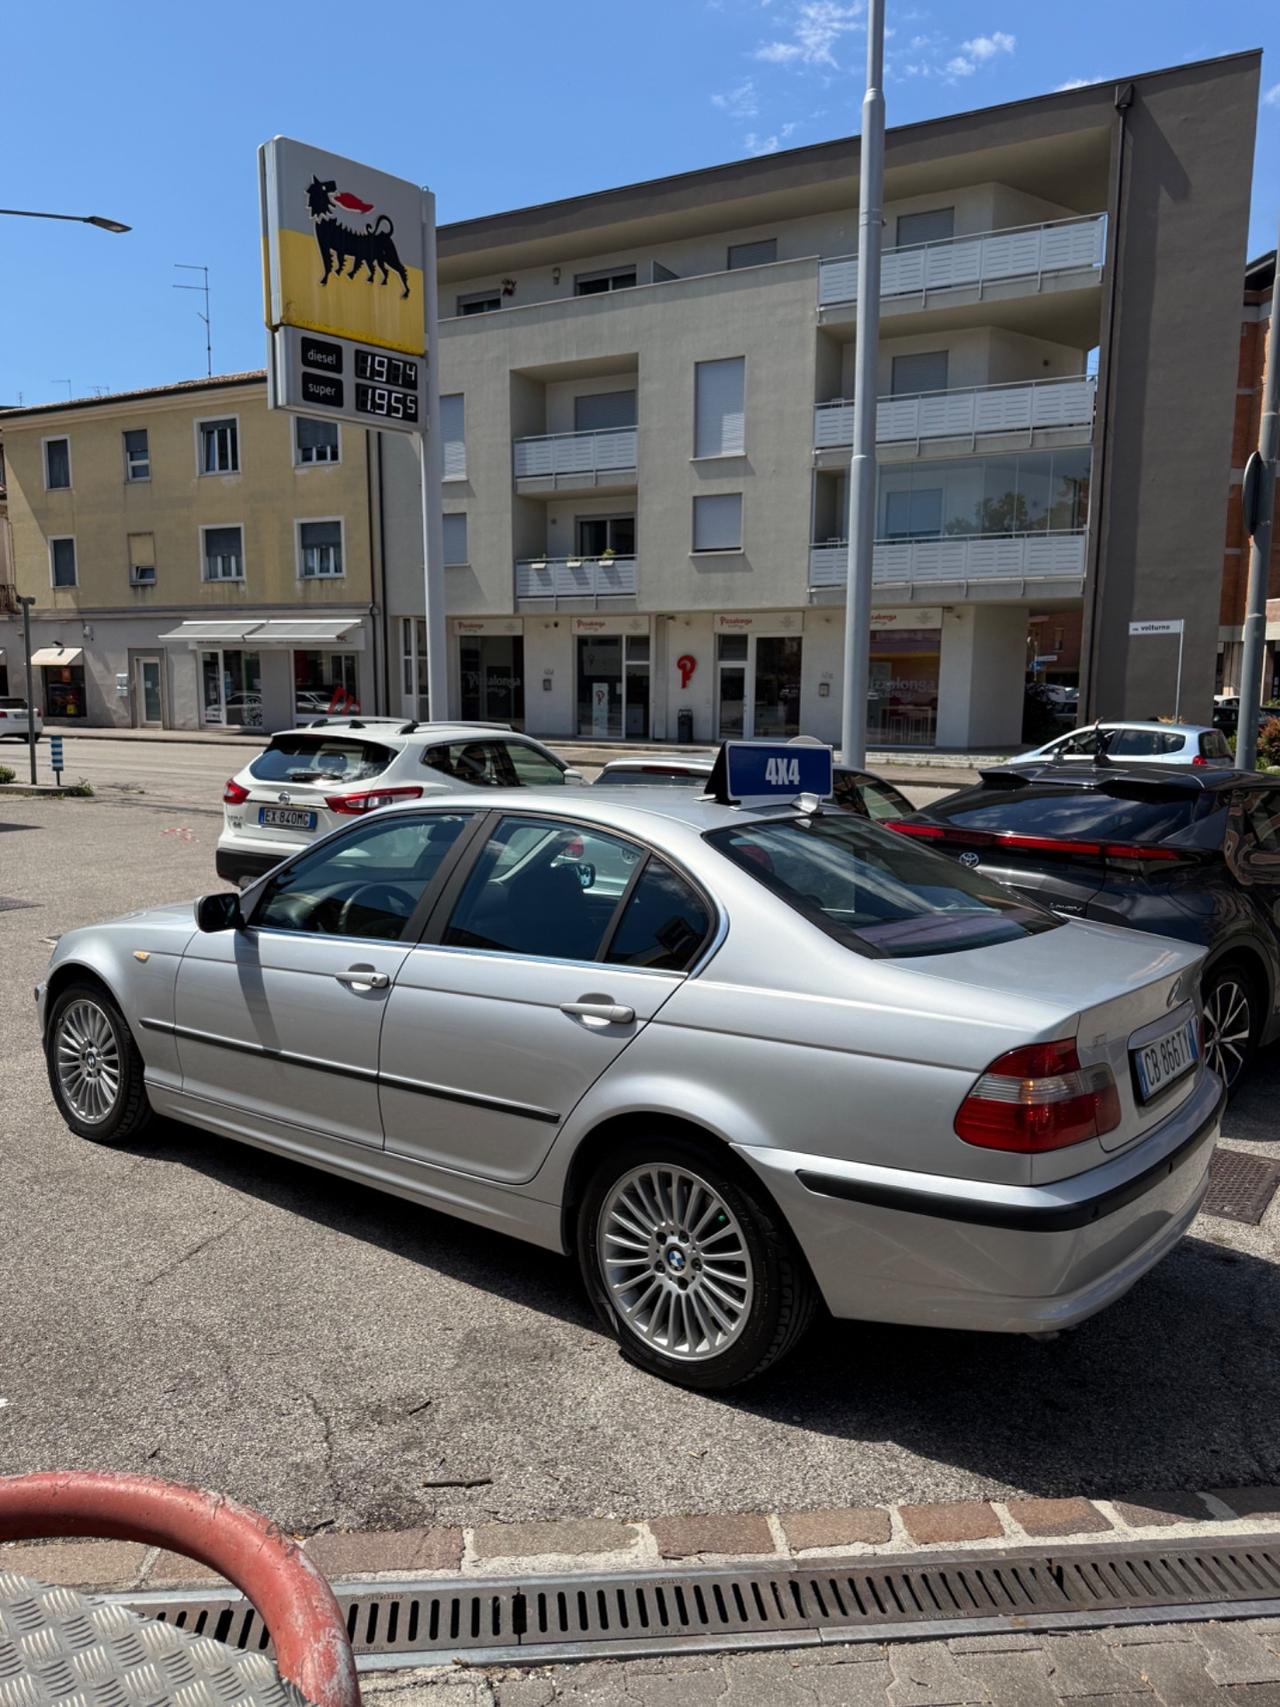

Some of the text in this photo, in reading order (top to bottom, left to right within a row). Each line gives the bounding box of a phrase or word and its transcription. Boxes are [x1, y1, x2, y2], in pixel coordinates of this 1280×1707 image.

[307, 349, 337, 365] diesel
[308, 383, 337, 397] super
[1141, 624, 1171, 632] volturno
[765, 757, 801, 786] 4X4
[265, 810, 277, 821] EX
[1144, 1047, 1161, 1087] CB
